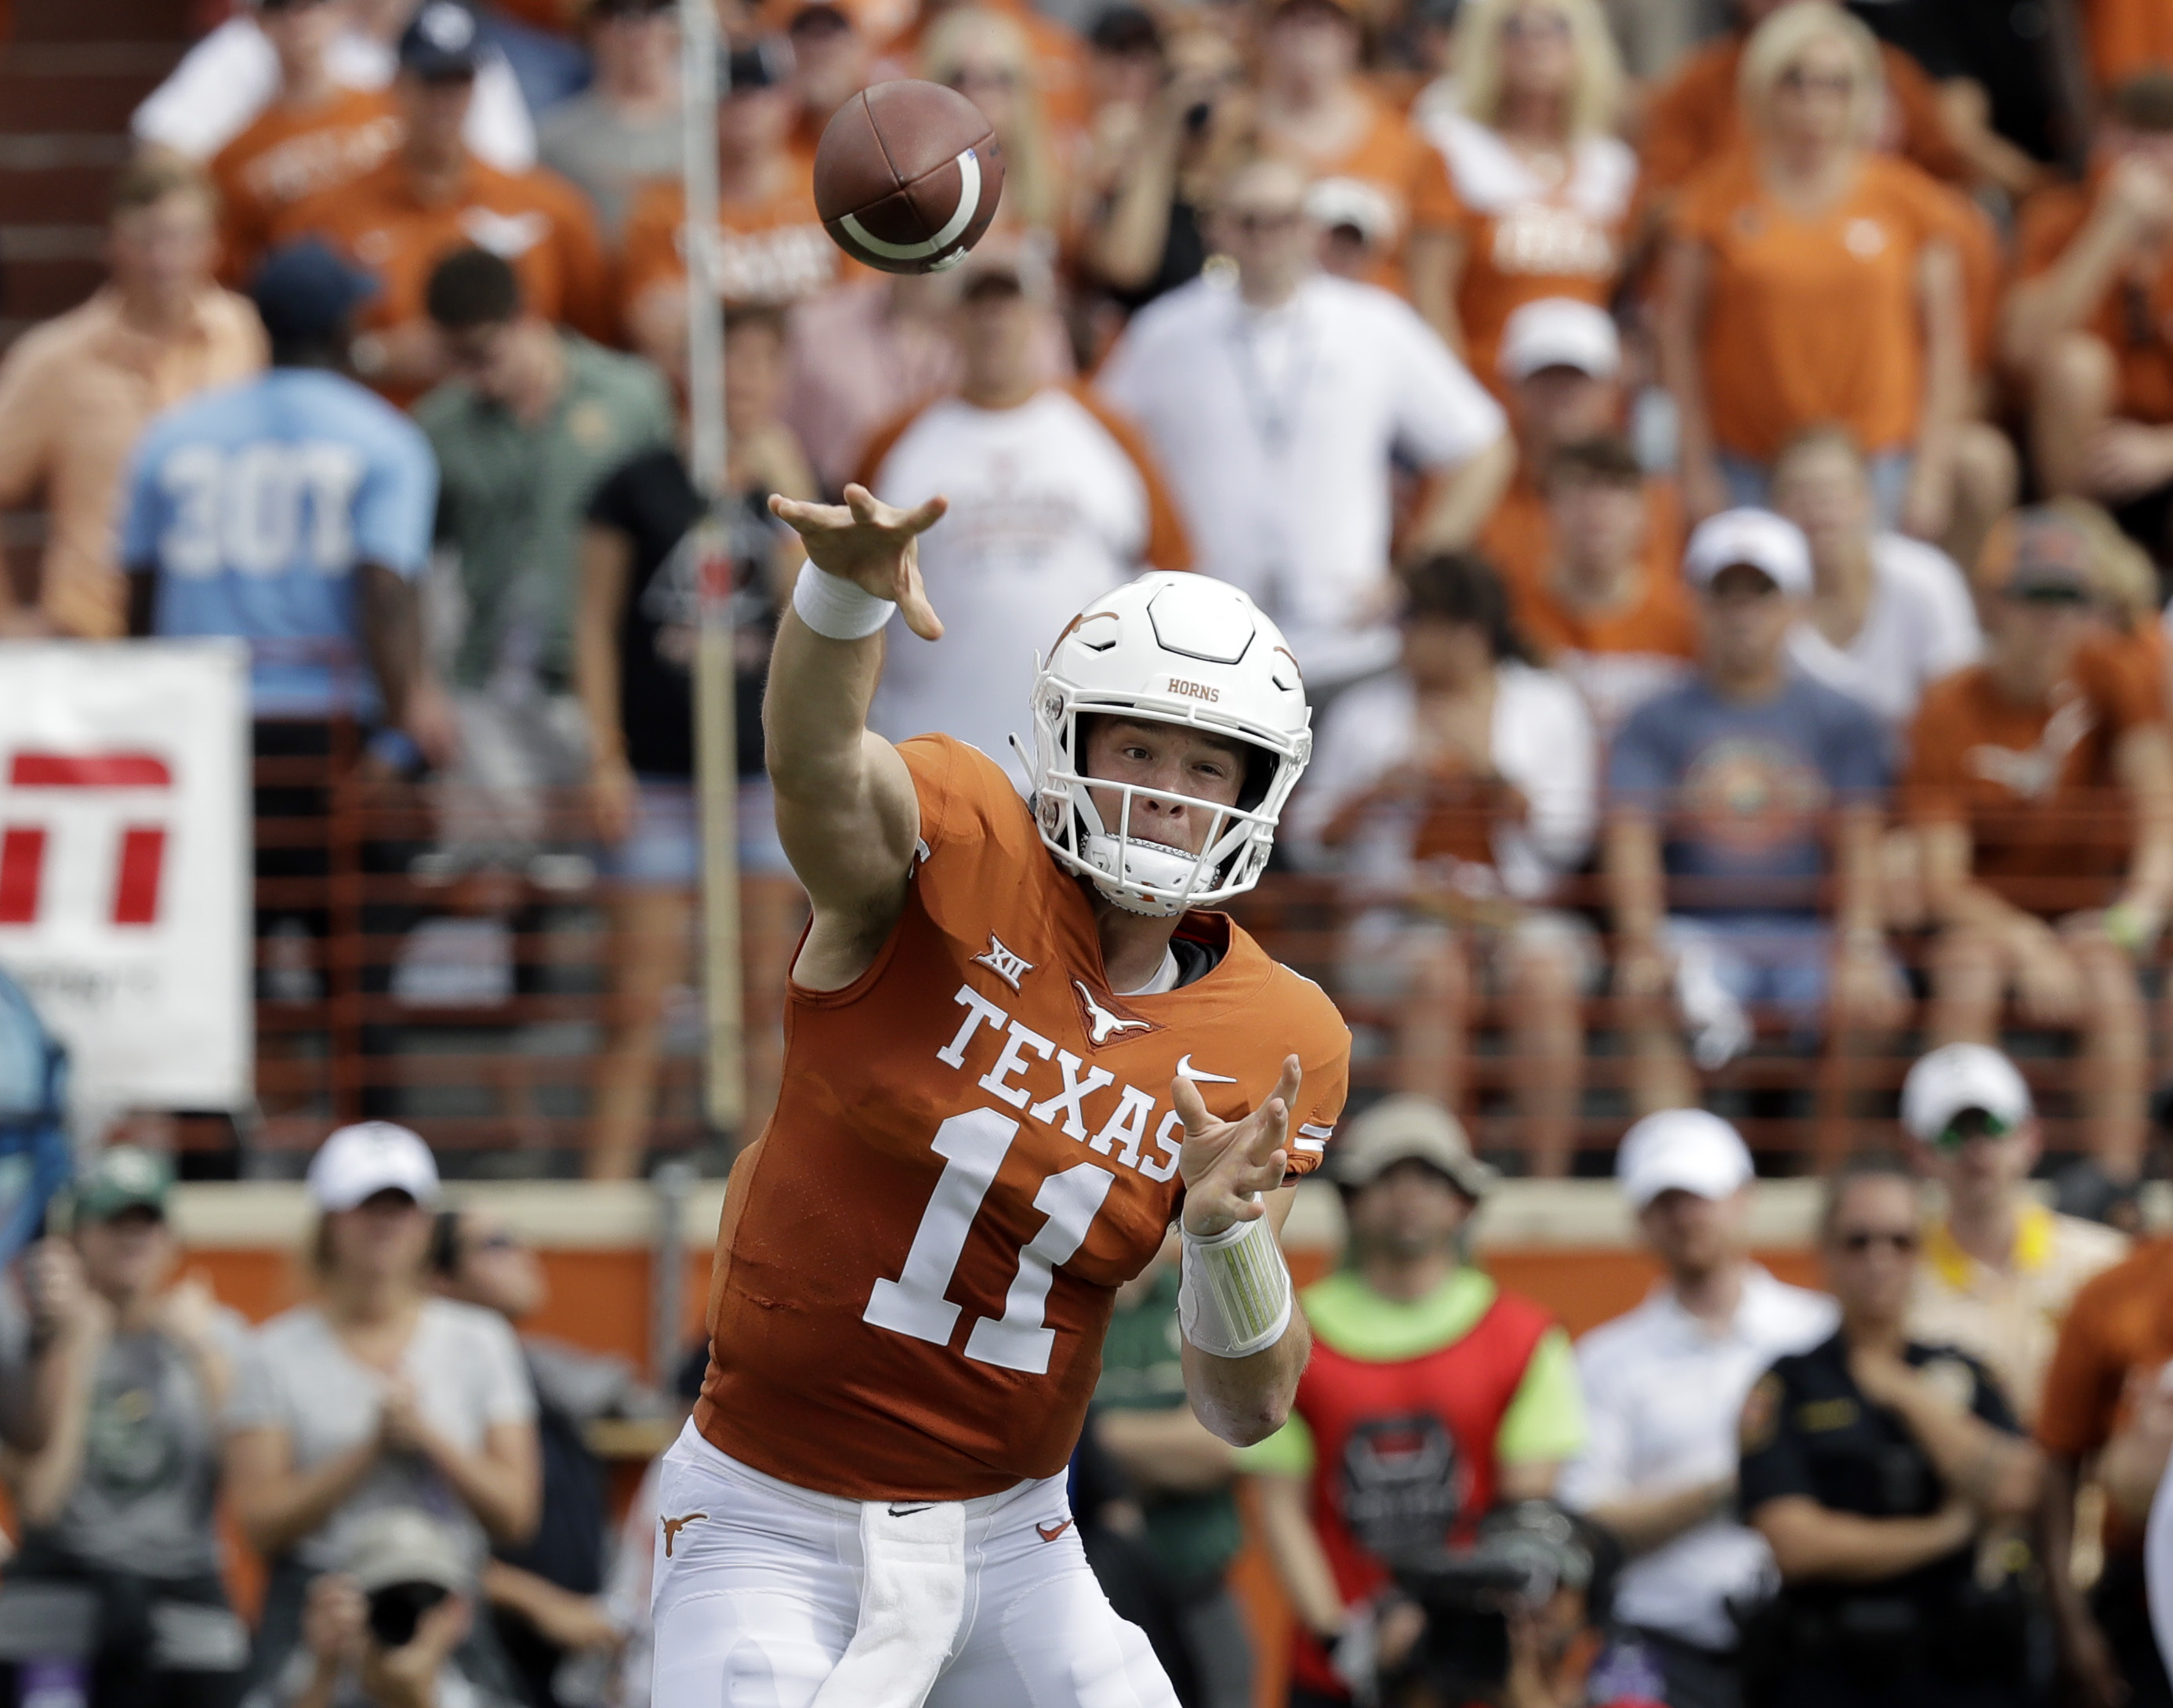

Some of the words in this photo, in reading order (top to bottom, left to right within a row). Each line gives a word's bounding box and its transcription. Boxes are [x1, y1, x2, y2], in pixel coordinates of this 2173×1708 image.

[1167, 678, 1220, 702] HORNS
[936, 984, 1183, 1183] TEXAS
[862, 1106, 1115, 1375] 11
